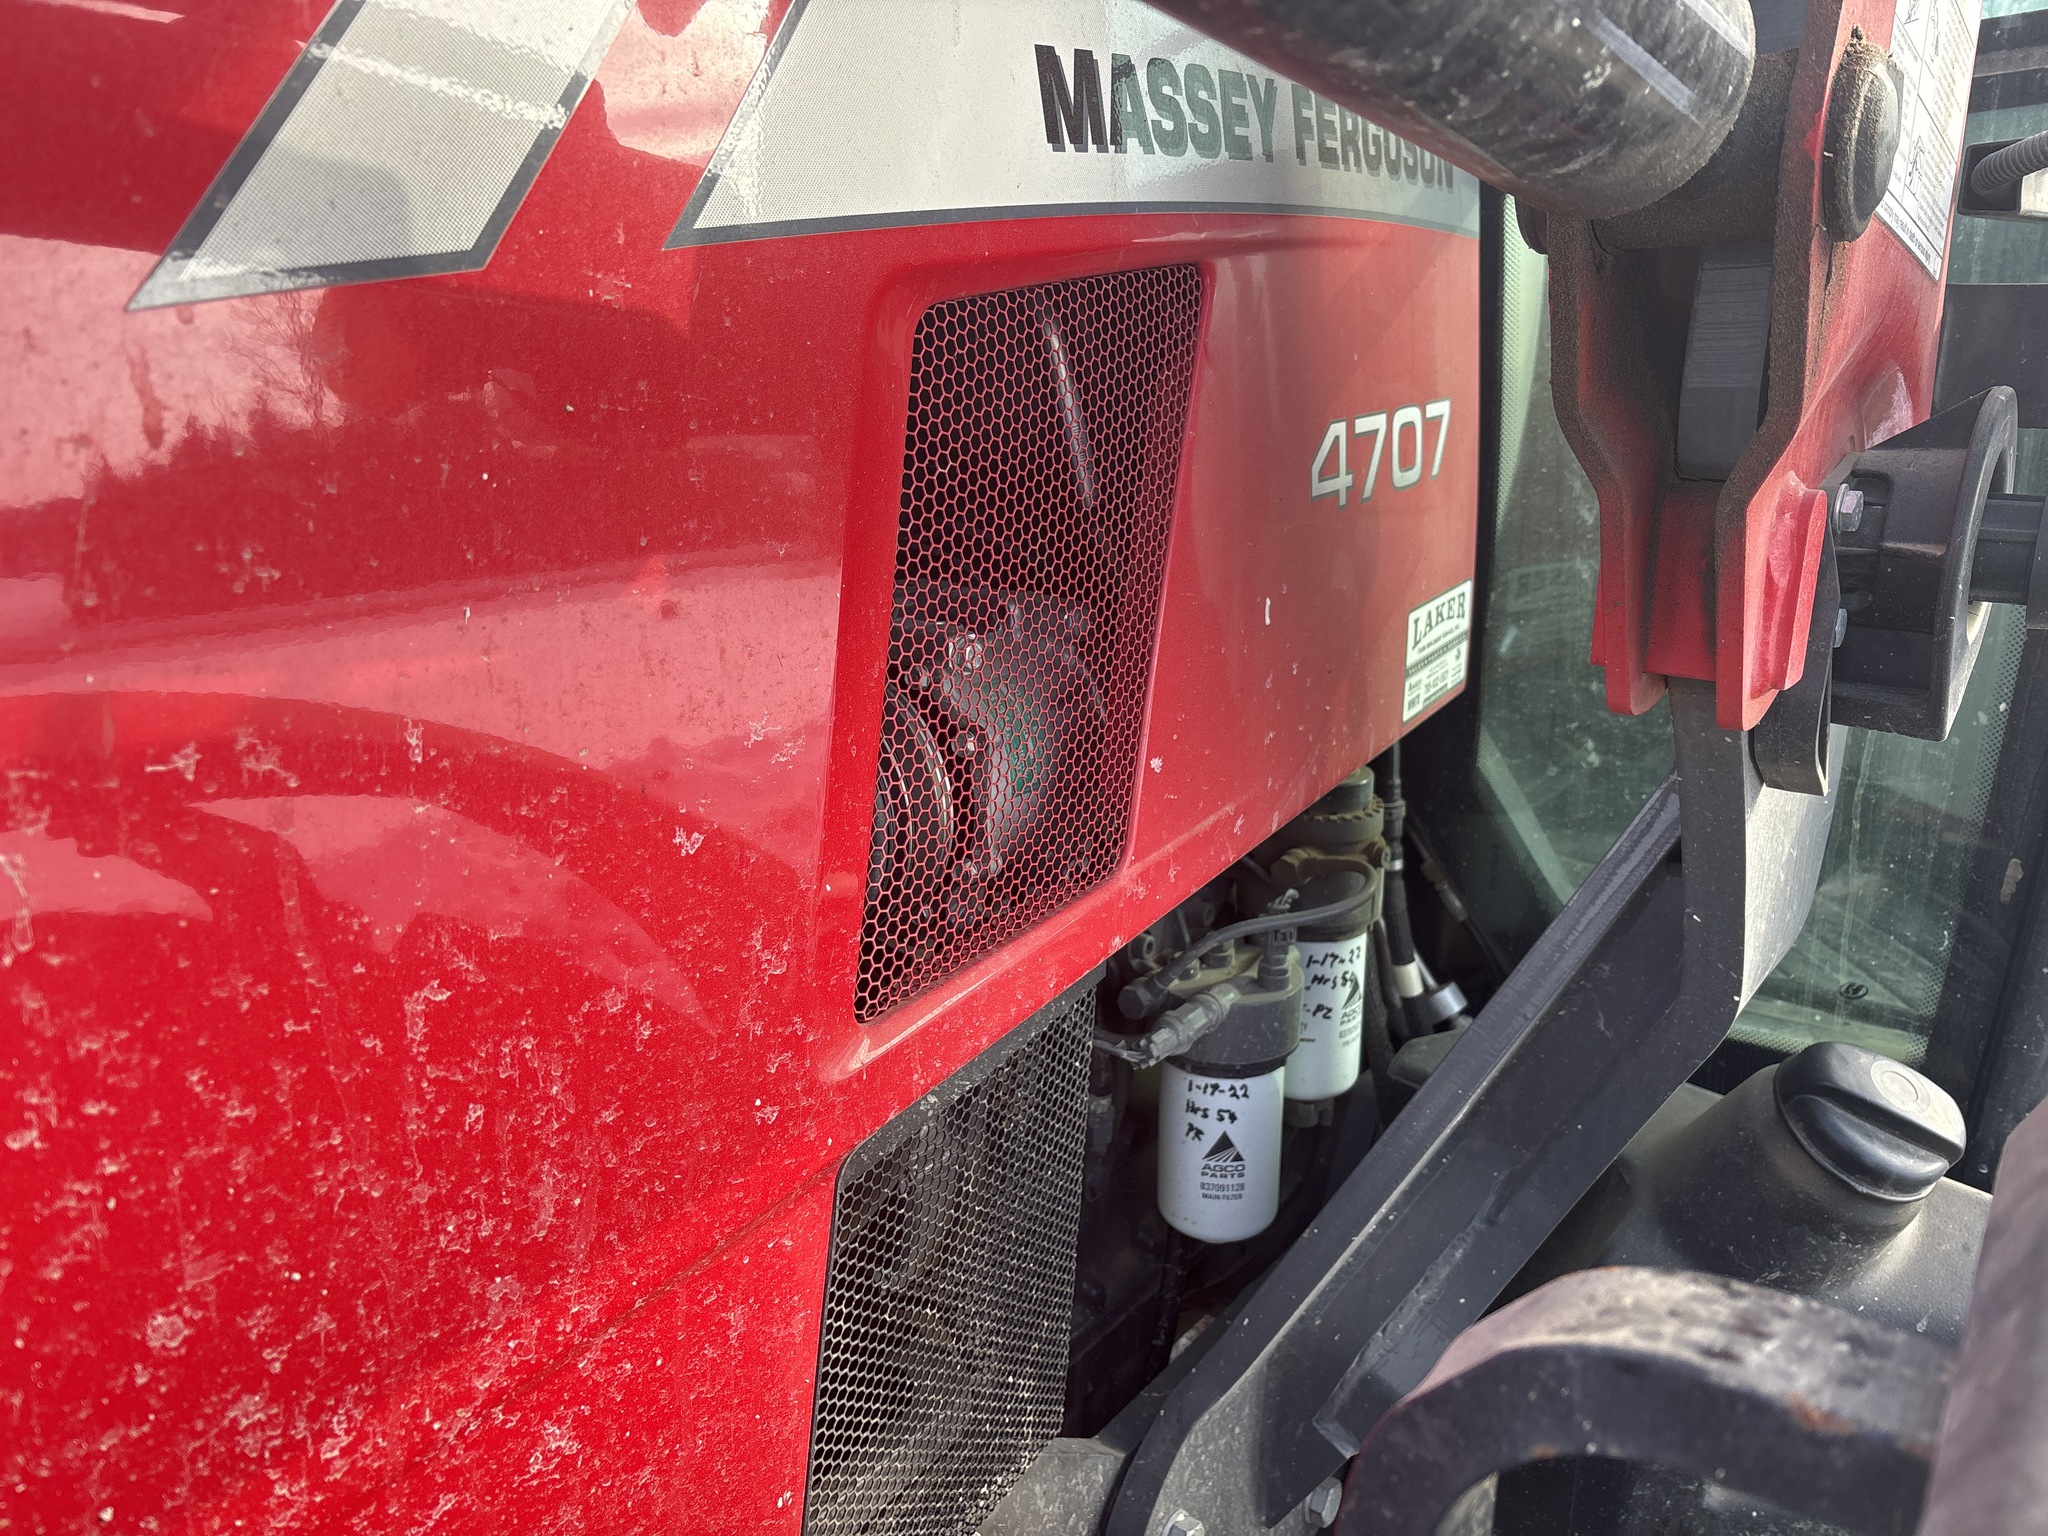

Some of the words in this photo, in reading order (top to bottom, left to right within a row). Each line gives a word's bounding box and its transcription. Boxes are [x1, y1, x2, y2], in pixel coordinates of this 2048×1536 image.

[1034, 44, 1278, 163] MASSEY
[1310, 398, 1451, 510] 4707
[1411, 592, 1466, 650] LAKER
[1200, 1171, 1246, 1179] PARTS
[1201, 1163, 1246, 1173] AGCO
